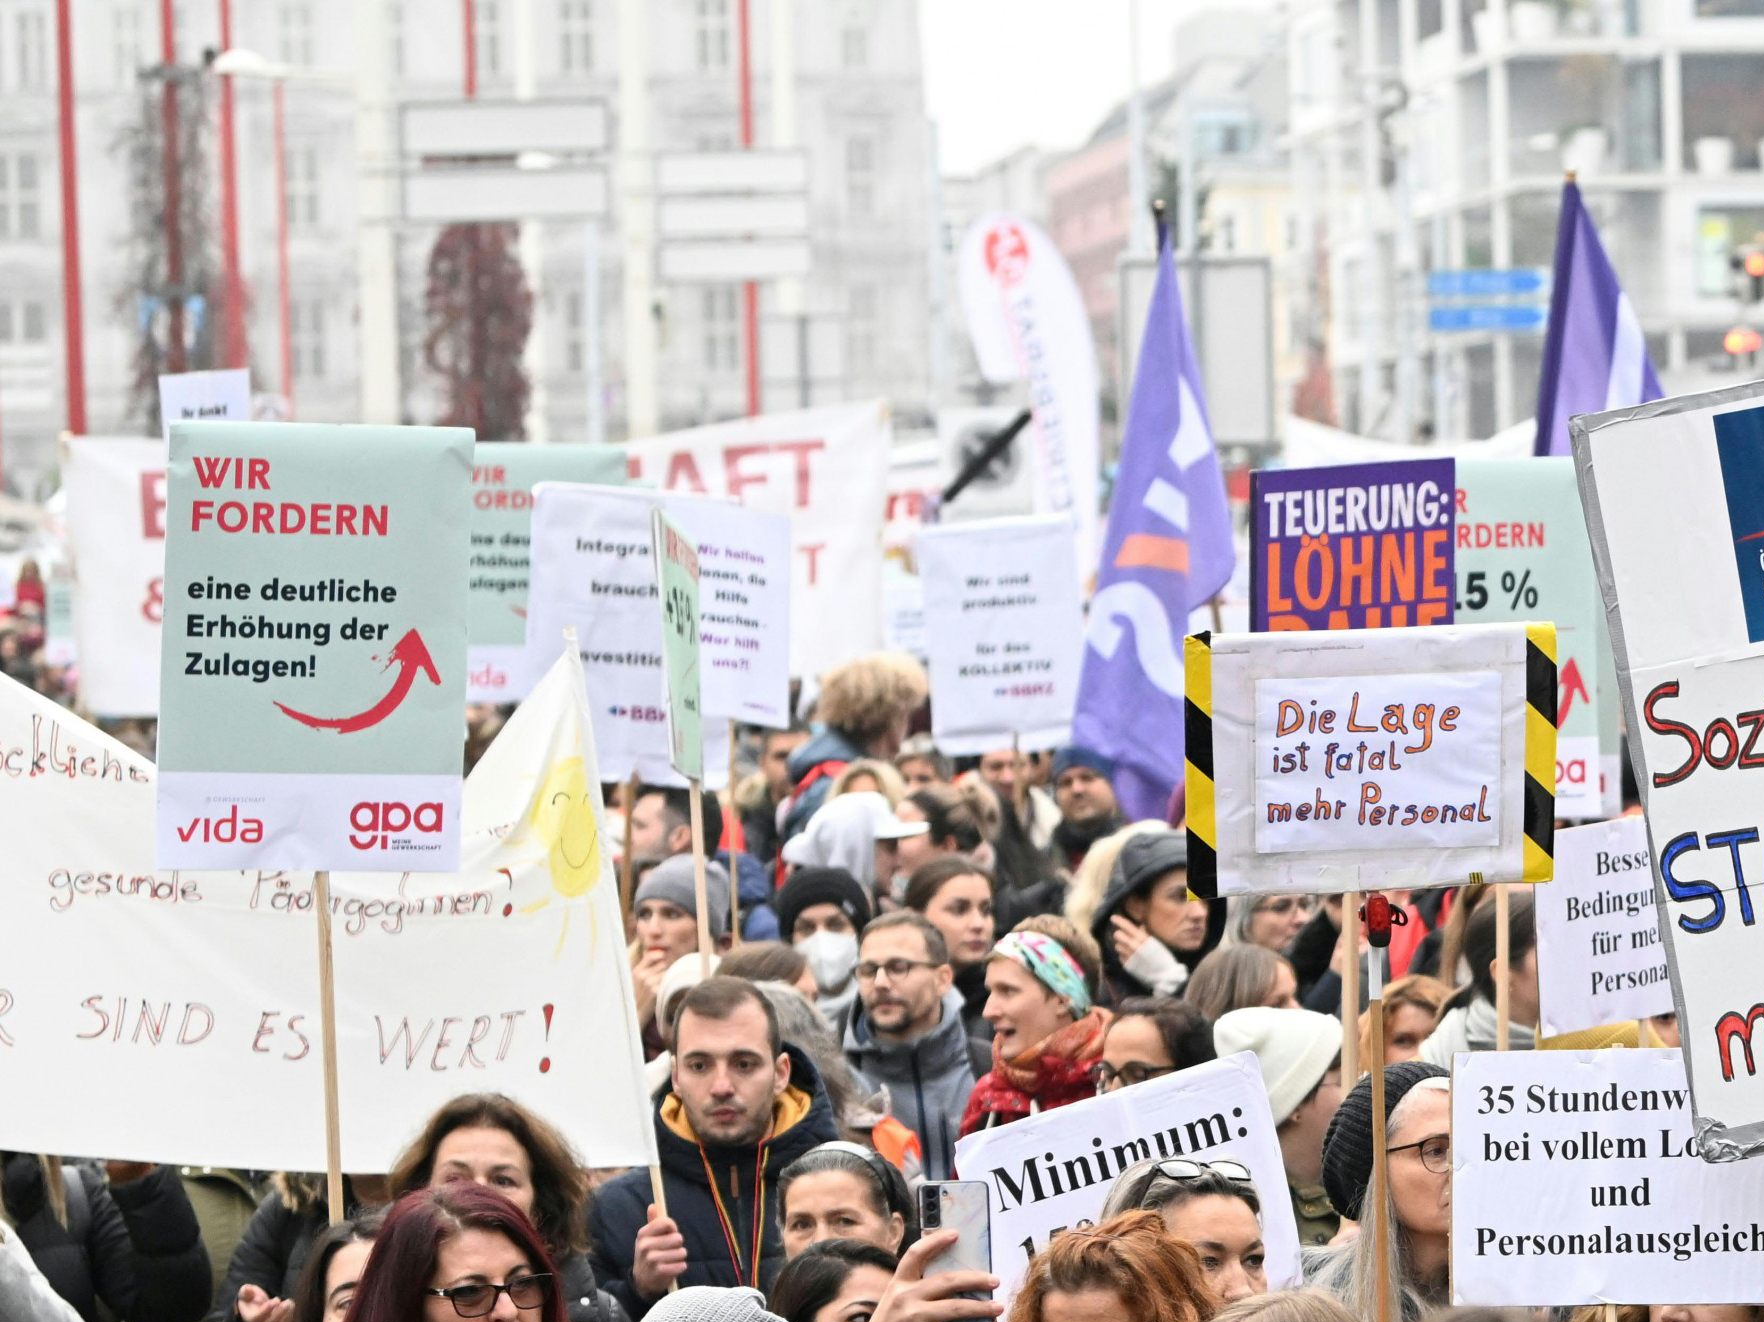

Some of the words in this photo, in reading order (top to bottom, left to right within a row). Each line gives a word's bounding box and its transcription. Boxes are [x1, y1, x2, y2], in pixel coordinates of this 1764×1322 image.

[193, 456, 272, 490] WIR
[473, 489, 536, 511] ORD
[1264, 481, 1450, 537] TEUERUNG:
[190, 500, 390, 537] FORDERN
[1456, 522, 1545, 549] RDERN
[470, 533, 494, 546] ine
[576, 537, 650, 558] Integra
[470, 556, 530, 570] rhöhun
[1266, 532, 1448, 614] LÖHNE
[187, 576, 251, 601] eine
[260, 577, 397, 606] deutliche
[470, 577, 529, 592] ulagen
[591, 580, 659, 598] brauch
[1501, 568, 1539, 611] %
[186, 613, 331, 646] Erhöhung
[340, 619, 389, 643] der
[700, 612, 760, 629] rauchen
[184, 651, 317, 683] Zulagen!
[470, 663, 507, 687] ida
[1276, 699, 1334, 738] Die
[1347, 692, 1461, 753] Lage
[0, 714, 150, 782] ckliche
[1273, 741, 1310, 774] ist
[1325, 741, 1402, 778] fatal
[1267, 787, 1347, 823] mehr
[1358, 781, 1492, 827] Personal
[177, 804, 264, 844] vida
[349, 801, 444, 851] gpa
[1591, 930, 1623, 957] für
[1591, 962, 1669, 996] Persona
[75, 994, 215, 1045] SIND
[252, 1011, 311, 1062] ES
[374, 1002, 555, 1074] WERT!
[1477, 1084, 1516, 1115] 35
[1526, 1080, 1689, 1116] Stundenw
[988, 1106, 1249, 1214] Minimum:
[1482, 1132, 1533, 1164] bei
[1541, 1129, 1647, 1162] vollem
[1658, 1128, 1700, 1161] Lo
[1589, 1178, 1652, 1210] und
